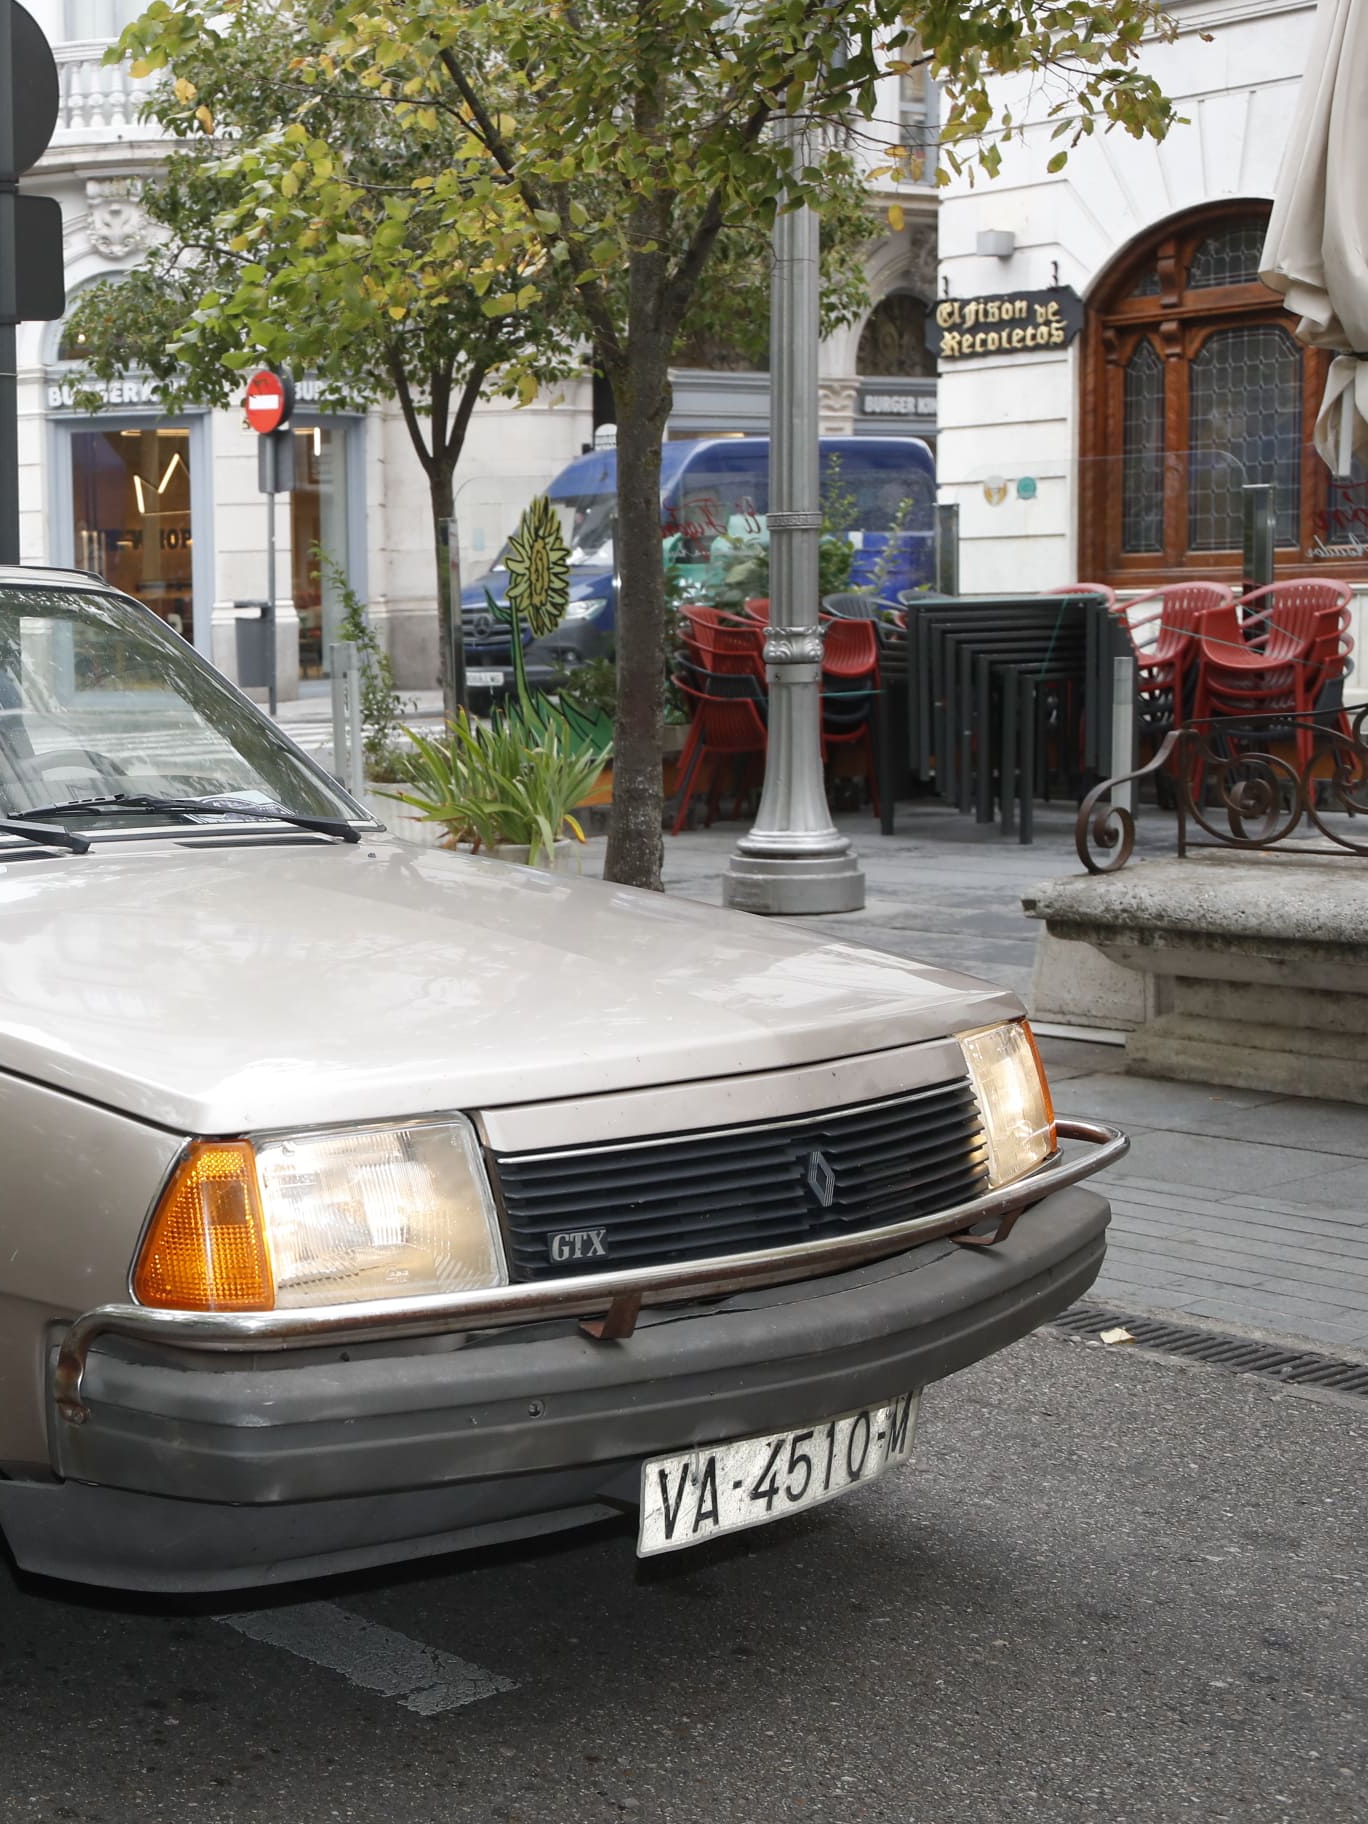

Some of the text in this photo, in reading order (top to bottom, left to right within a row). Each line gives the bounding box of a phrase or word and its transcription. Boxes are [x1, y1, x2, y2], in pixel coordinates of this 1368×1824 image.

[936, 301, 962, 328] El
[1034, 301, 1062, 324] de
[940, 321, 1068, 357] Recoletos
[864, 395, 938, 414] BURGER KIN
[552, 1229, 607, 1261] GTX
